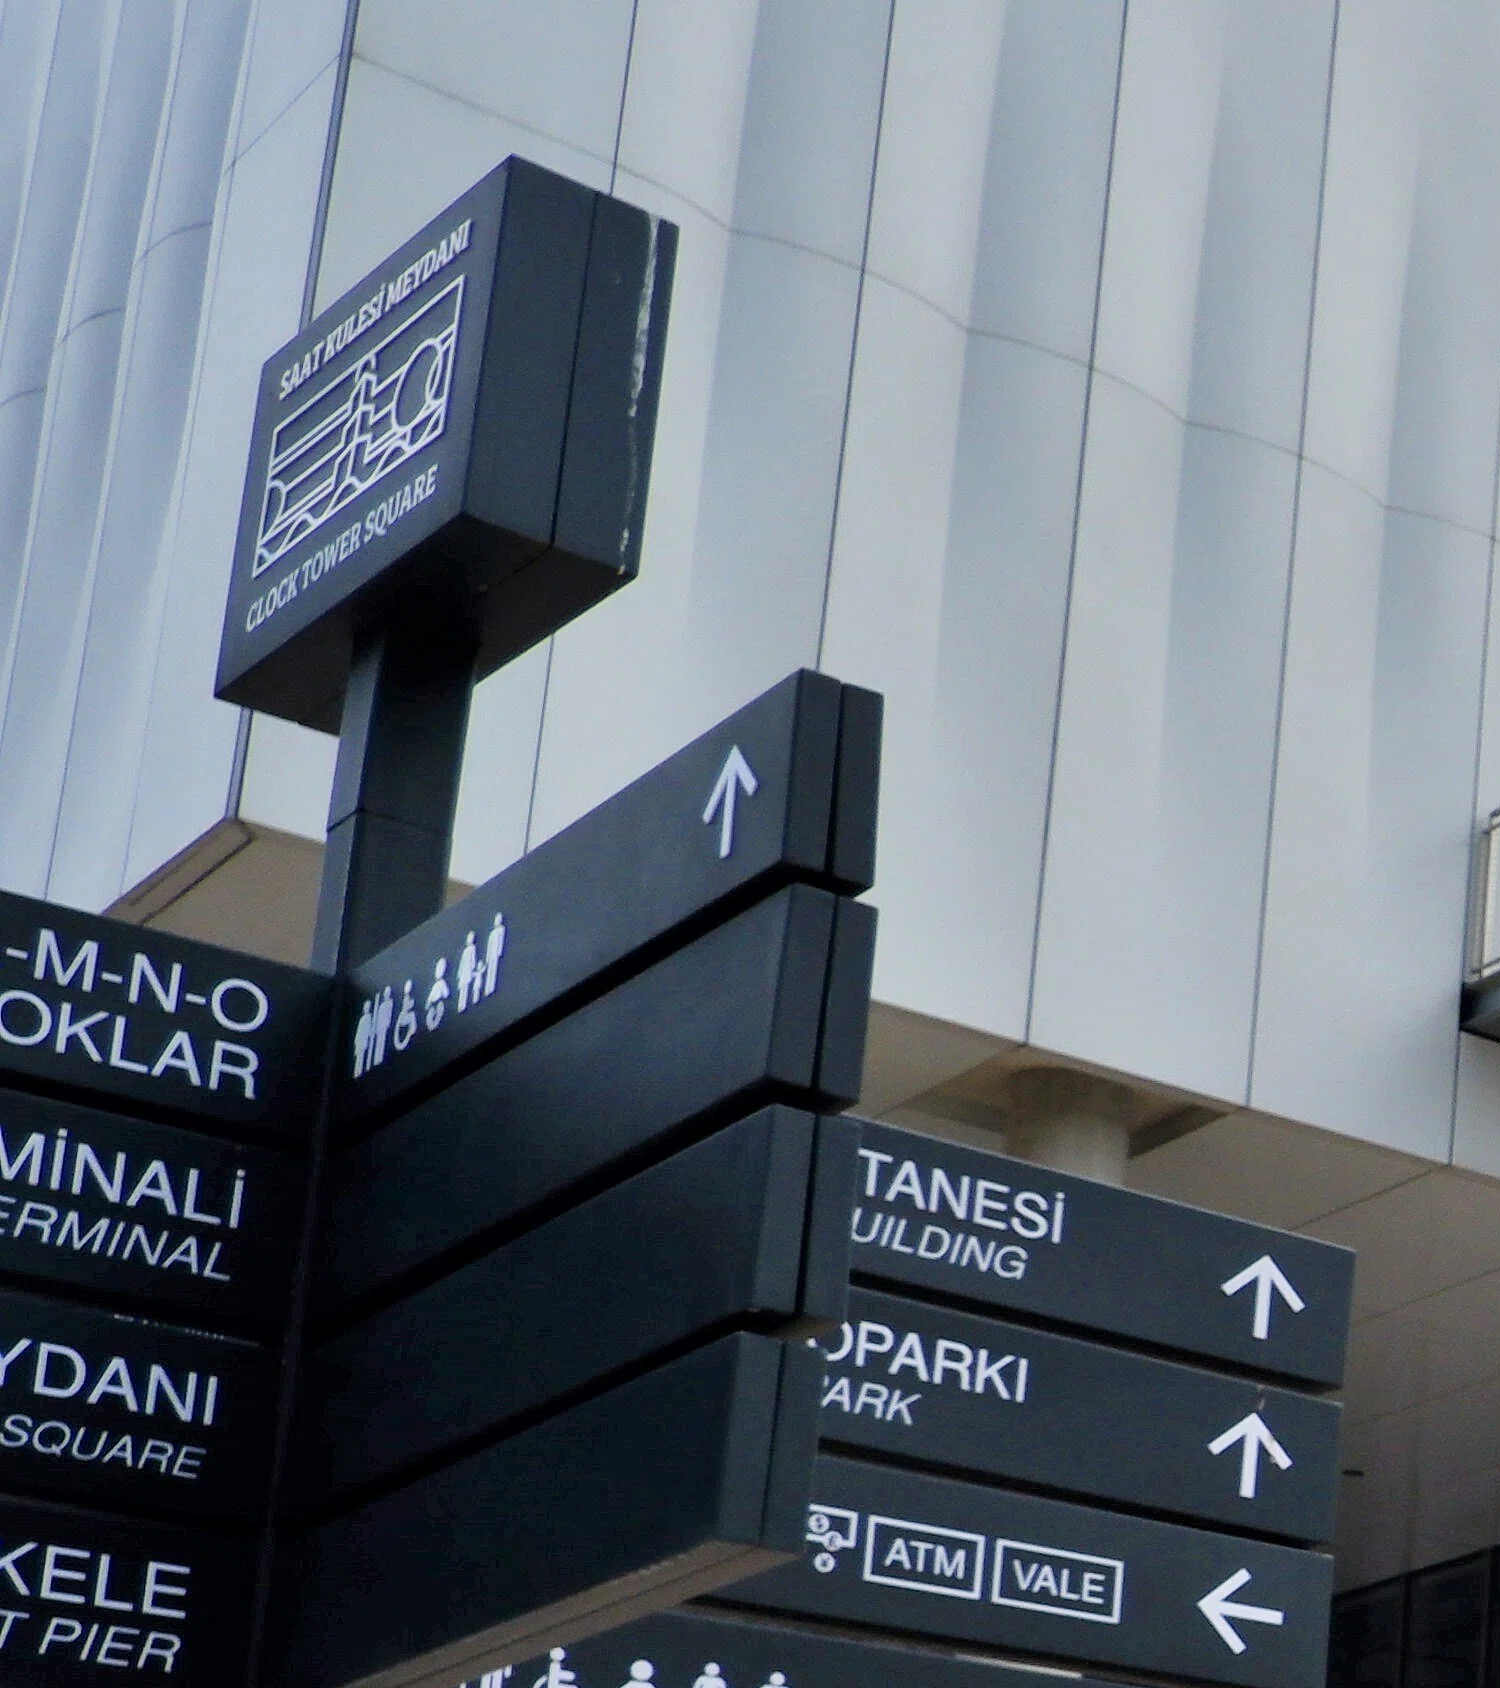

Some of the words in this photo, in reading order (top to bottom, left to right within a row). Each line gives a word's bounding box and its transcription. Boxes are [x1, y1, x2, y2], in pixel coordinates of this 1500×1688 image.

[279, 339, 325, 401] SAAT
[323, 283, 386, 365] KULESİ
[384, 218, 472, 312] MEYDANI
[245, 568, 300, 633] CLOCK
[302, 521, 362, 590] TOWER
[363, 464, 439, 544] SQUARE
[0, 989, 260, 1100] OKLAR
[857, 1147, 1066, 1245] TANESİ
[820, 1374, 923, 1426] ARK
[0, 1414, 207, 1480] SQUARE
[883, 1538, 966, 1580] ATM
[1012, 1558, 1106, 1605] VALE
[38, 1616, 182, 1675] PIER
